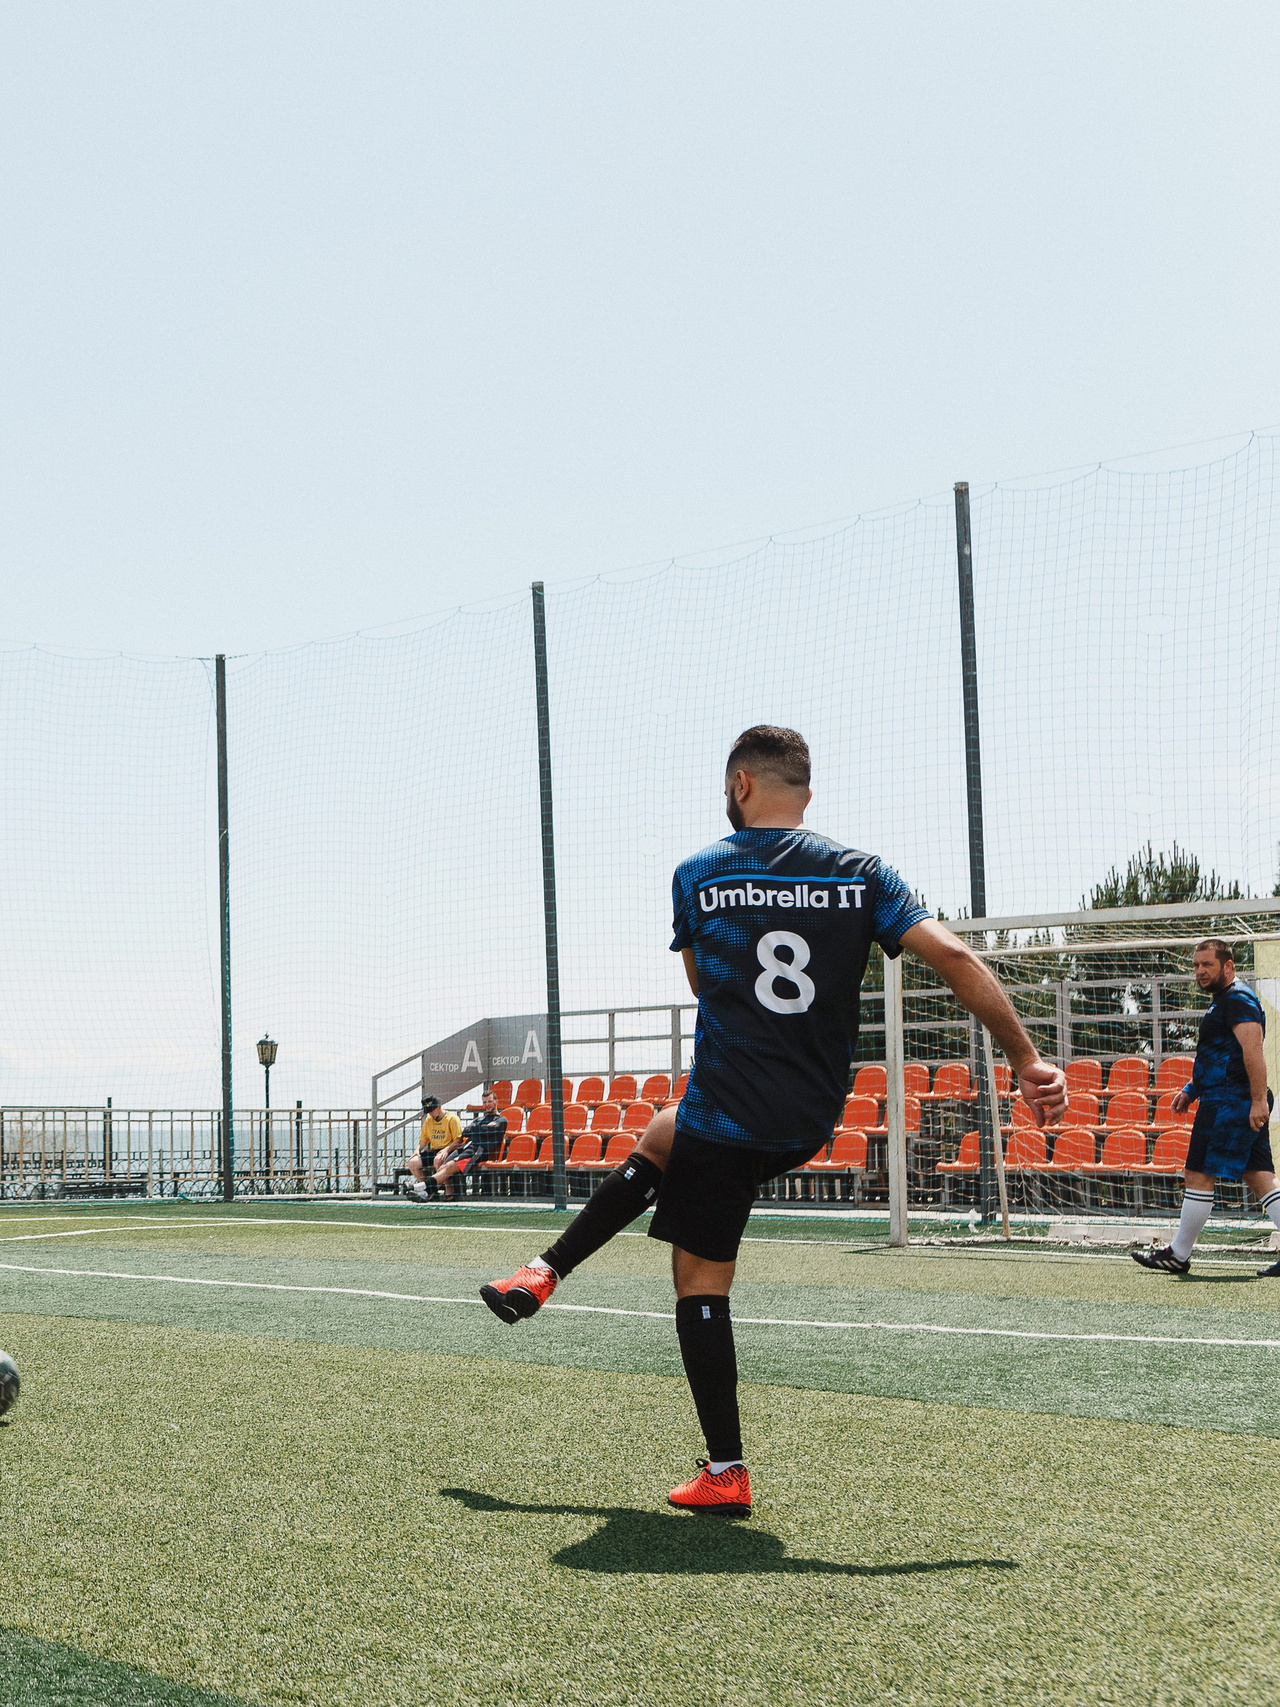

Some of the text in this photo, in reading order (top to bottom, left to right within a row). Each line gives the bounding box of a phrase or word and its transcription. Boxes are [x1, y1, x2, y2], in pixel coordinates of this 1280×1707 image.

[699, 882, 867, 912] Umbrella IT
[754, 930, 816, 1015] 8
[429, 1040, 484, 1074] СЕКТОР А
[492, 1030, 543, 1066] СЕКТОР А
